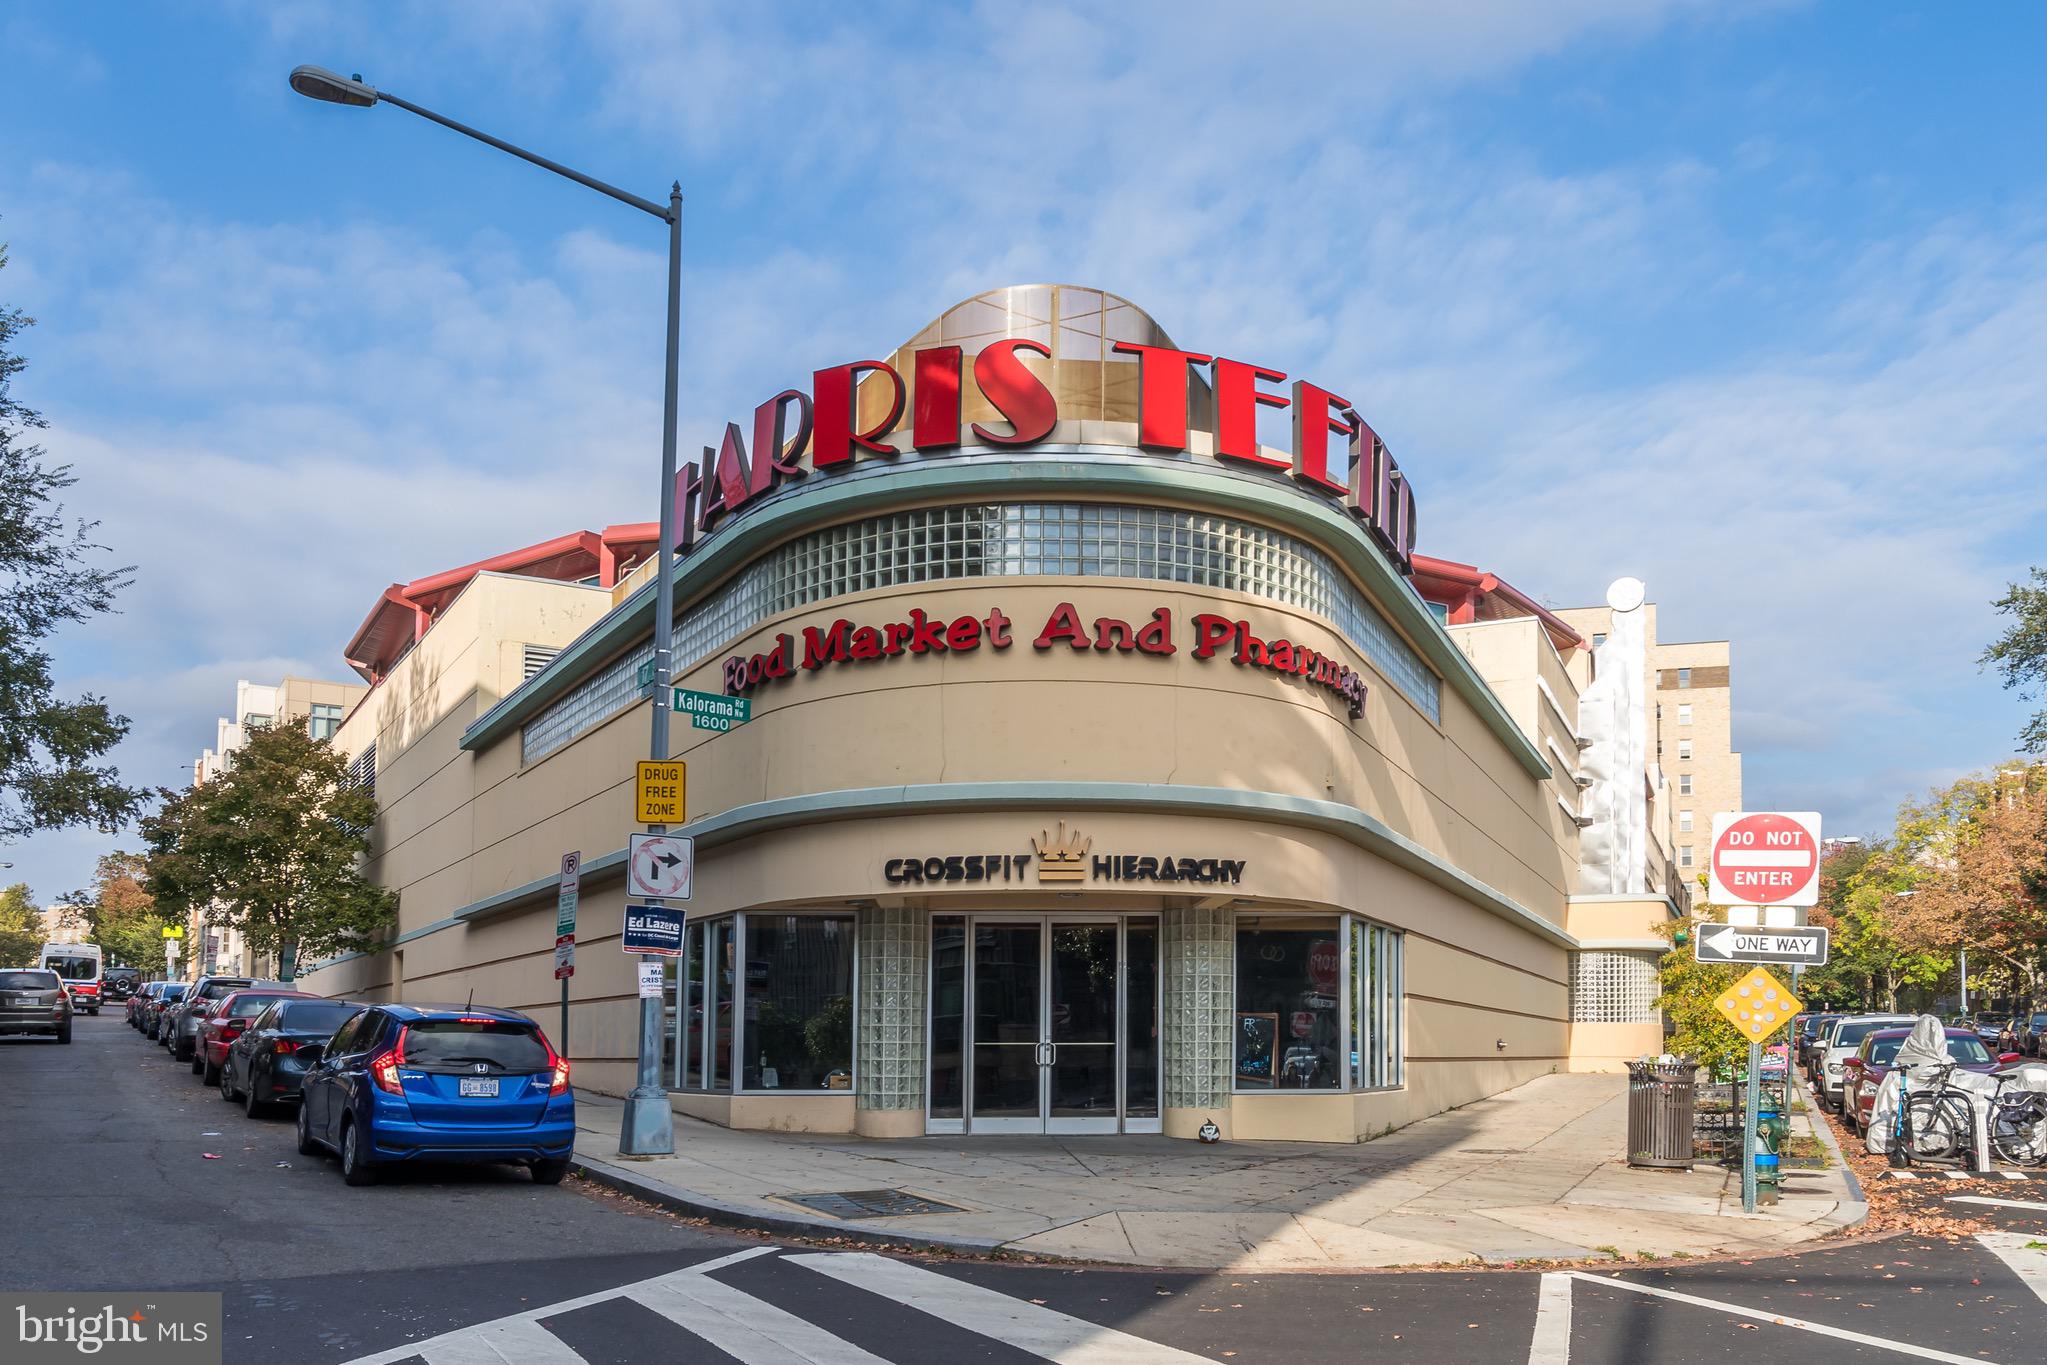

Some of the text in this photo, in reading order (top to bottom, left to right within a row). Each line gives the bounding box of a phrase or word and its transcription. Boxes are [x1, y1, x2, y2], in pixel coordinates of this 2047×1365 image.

[674, 338, 1057, 553] HARRIS
[723, 602, 1369, 719] Food Market And Pharmacy
[678, 692, 744, 716] Kalorama Rd
[694, 715, 729, 731] 1600
[644, 768, 679, 780] DRUG
[646, 786, 677, 798] FREE
[646, 803, 676, 815] ZONE
[1729, 831, 1804, 846] DO NOT
[884, 854, 1247, 884] CROSSFIT HIERARCHY
[1733, 871, 1793, 886] ENTER
[628, 916, 680, 931] Ed Lazere
[1735, 937, 1812, 953] ONE WAY
[462, 1082, 497, 1093] GG 8598
